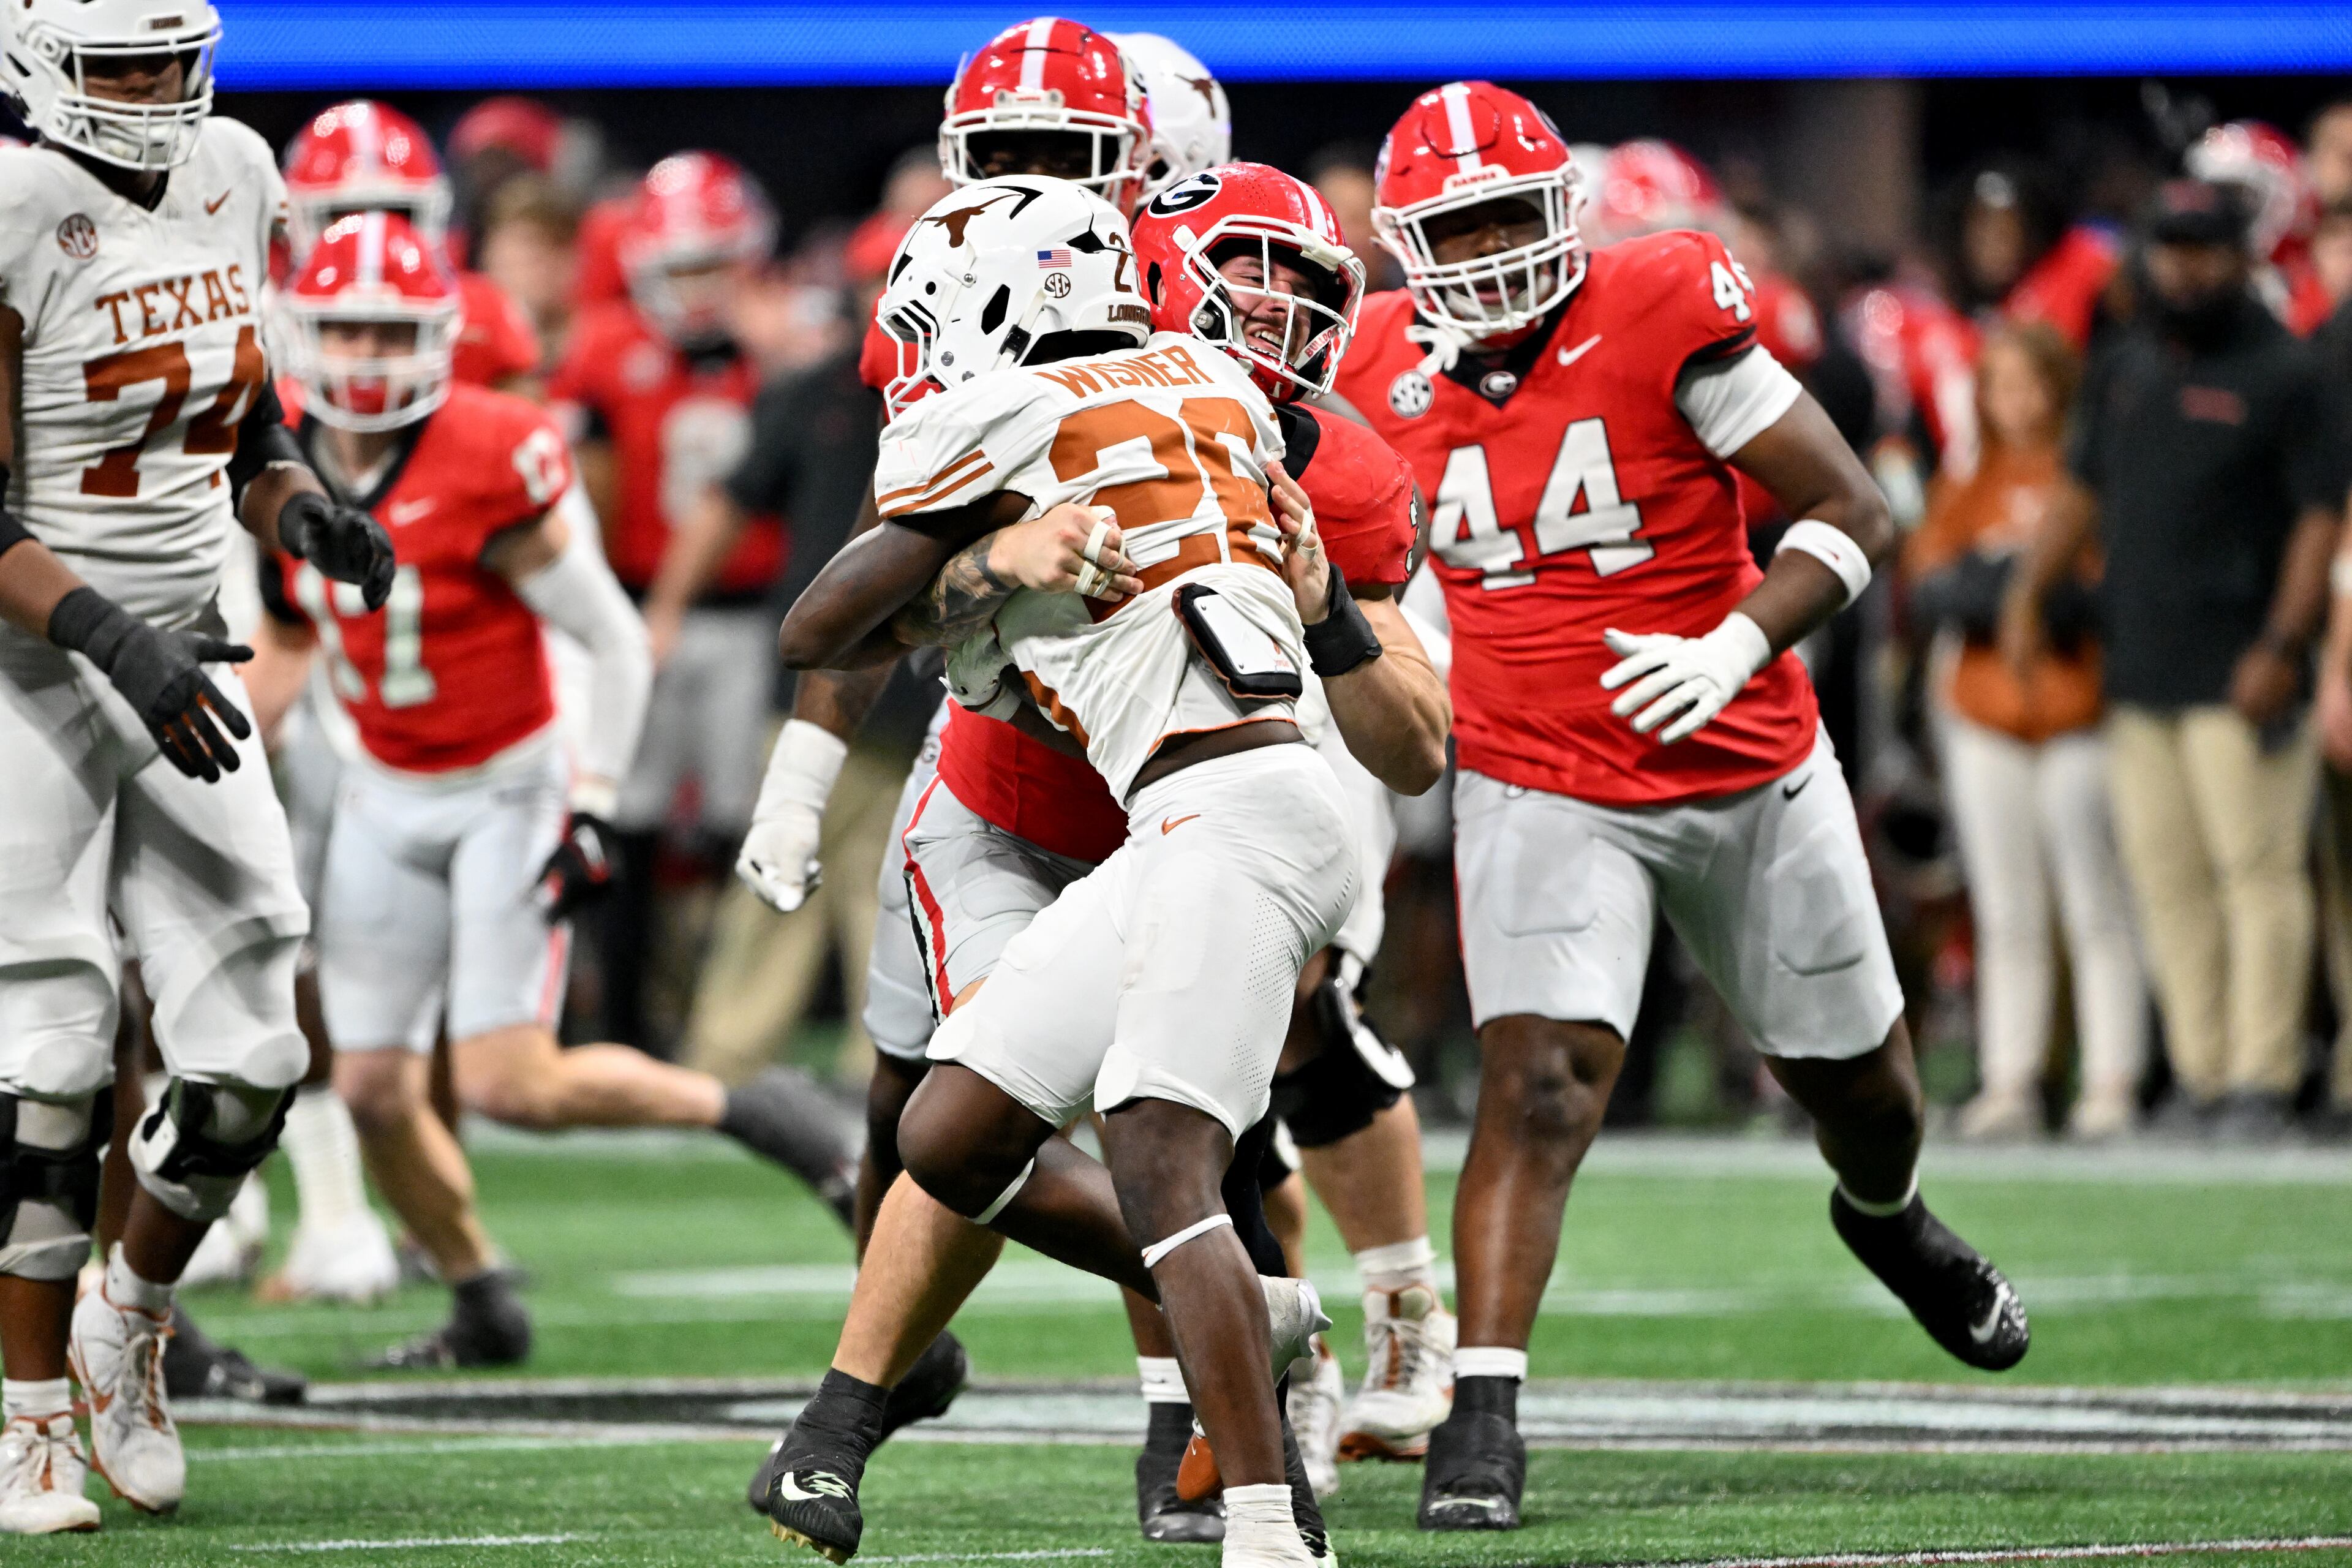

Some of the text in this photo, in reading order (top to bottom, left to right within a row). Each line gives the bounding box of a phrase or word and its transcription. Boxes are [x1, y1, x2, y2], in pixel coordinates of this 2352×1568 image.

[94, 264, 250, 344] TEXAS
[1044, 273, 1071, 298] SEC
[80, 324, 265, 497] 74
[1032, 345, 1215, 398] WISNER
[1429, 416, 1655, 590] 44
